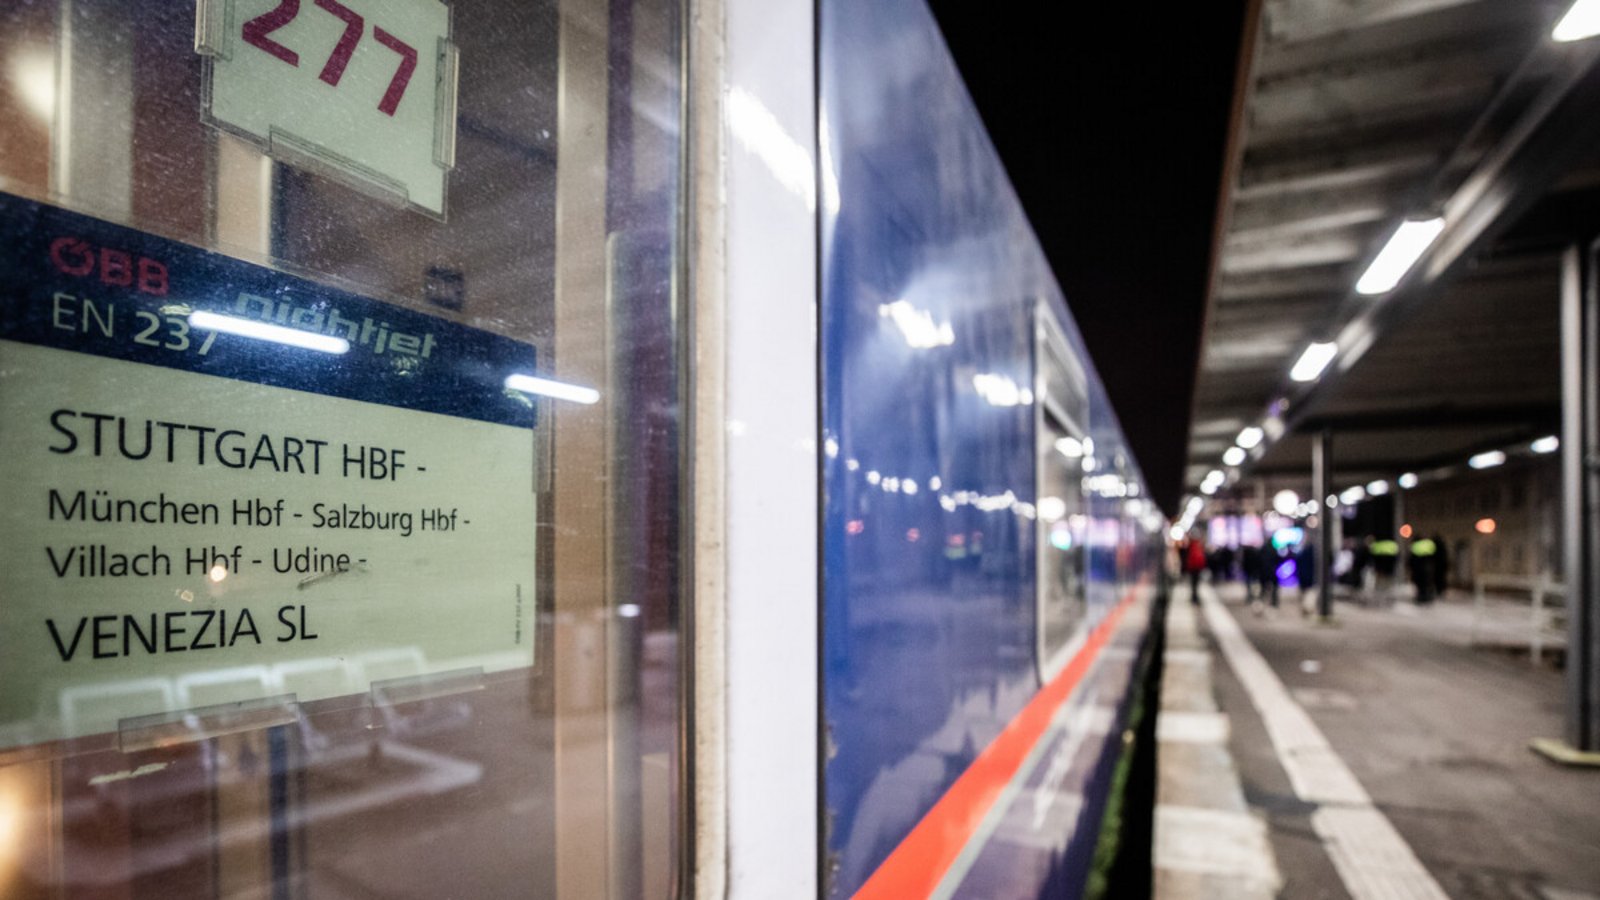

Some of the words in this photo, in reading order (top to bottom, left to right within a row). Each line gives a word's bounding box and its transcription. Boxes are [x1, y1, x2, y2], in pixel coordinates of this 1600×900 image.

[242, 0, 418, 117] 277
[52, 291, 115, 338] EN
[48, 410, 327, 475] STUTTGART
[342, 444, 406, 481] HBF
[48, 490, 219, 525] München
[232, 499, 285, 527] Hbf
[312, 503, 413, 537] Salzburg
[420, 509, 458, 531] Hbf
[47, 546, 171, 578] Villach
[186, 547, 243, 576] Hbf
[273, 547, 350, 574] Udine
[47, 608, 262, 662] VENEZIA
[277, 605, 318, 643] SL
